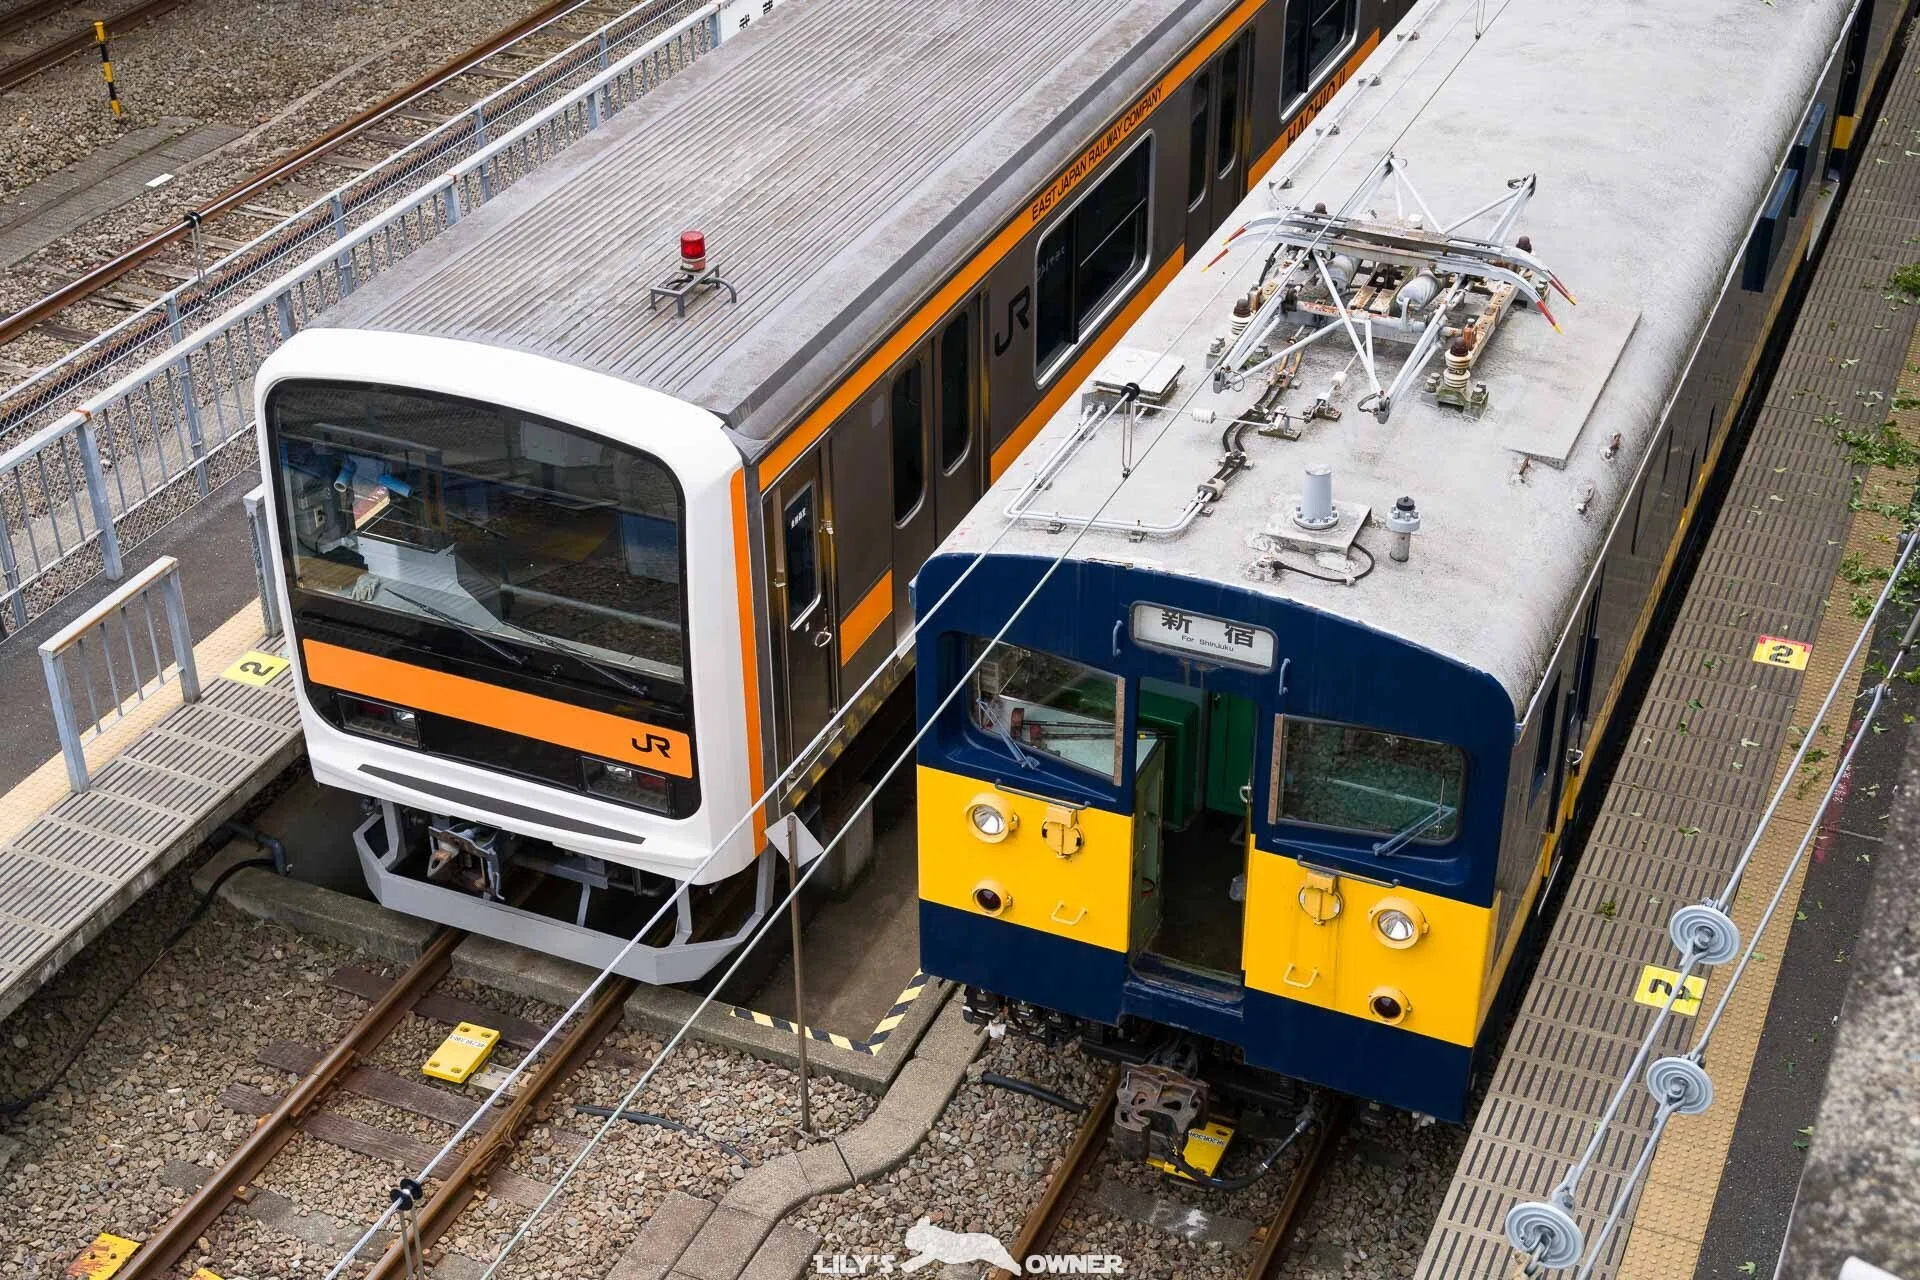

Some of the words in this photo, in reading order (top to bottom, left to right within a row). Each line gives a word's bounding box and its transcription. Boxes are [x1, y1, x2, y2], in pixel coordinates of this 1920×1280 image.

[1032, 186, 1057, 221] EAST
[1058, 158, 1087, 196] JAPAN
[1088, 122, 1123, 168] RAILWAY
[1123, 84, 1163, 133] COMPANY
[994, 285, 1031, 357] JR
[1161, 609, 1256, 649] 新宿
[1181, 634, 1195, 643] For
[1769, 645, 1793, 664] 2
[240, 662, 274, 676] 2
[631, 733, 671, 759] JR
